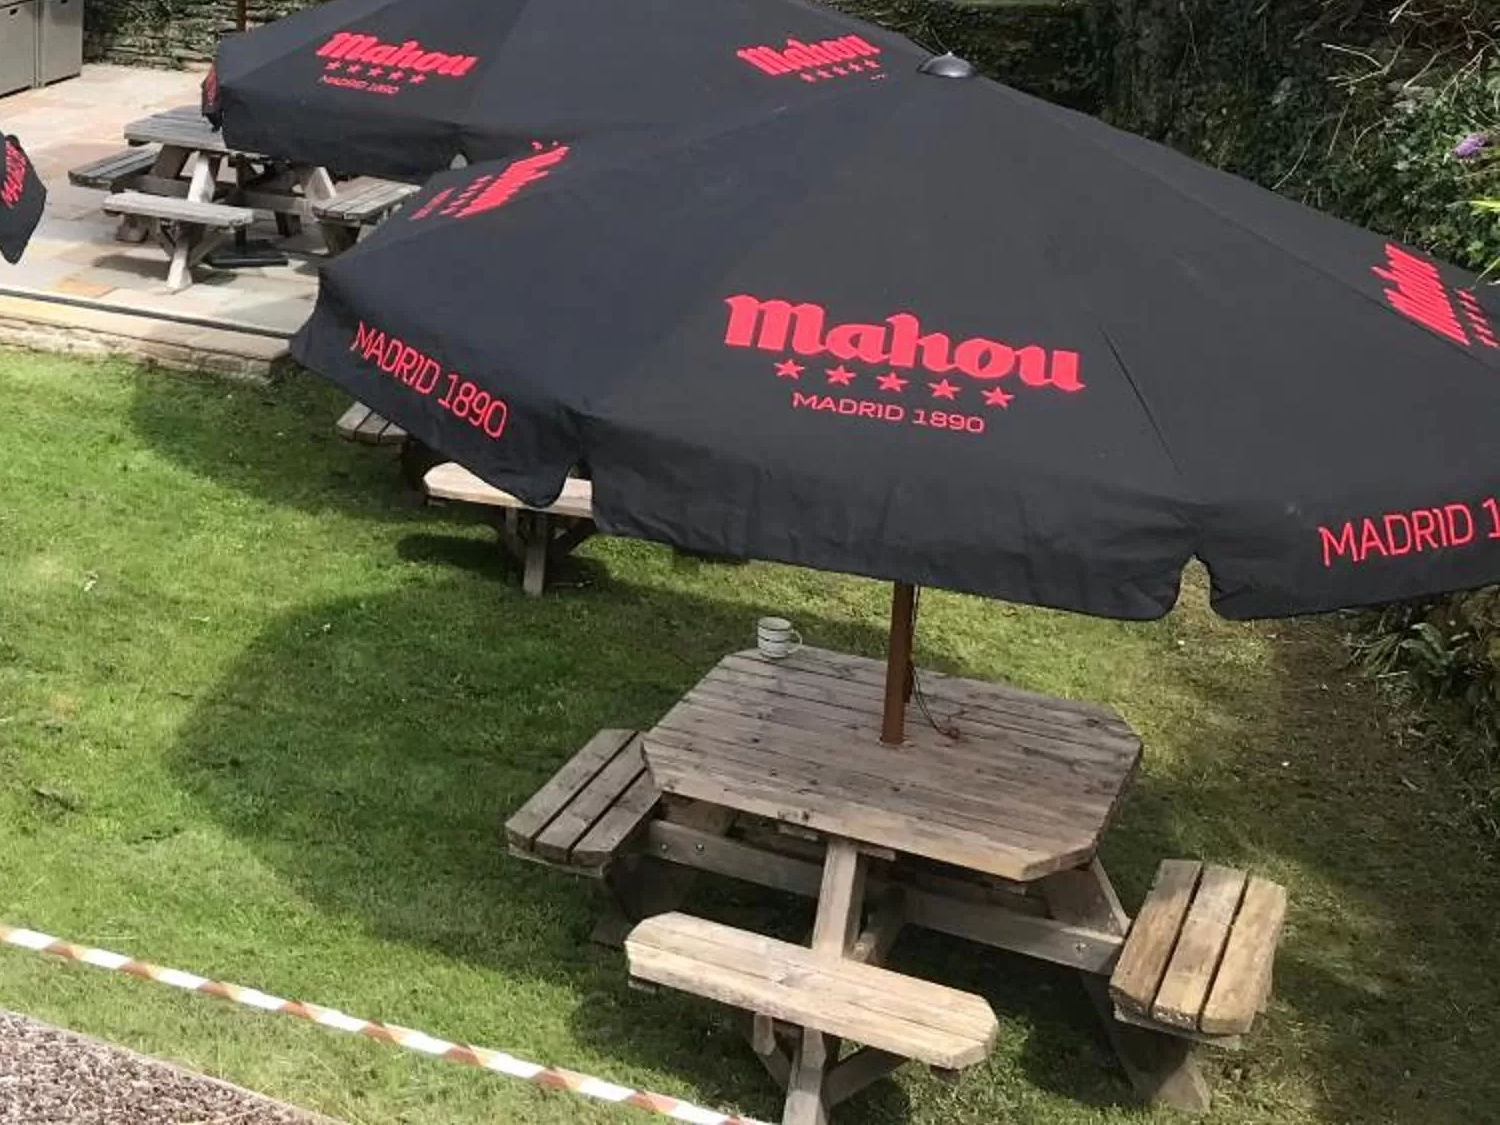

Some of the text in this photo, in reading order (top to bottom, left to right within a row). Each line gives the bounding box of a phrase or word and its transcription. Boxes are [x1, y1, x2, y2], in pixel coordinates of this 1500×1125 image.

[315, 32, 479, 77] Mahou
[736, 34, 881, 76] Mahou
[723, 294, 1085, 392] Mahou
[350, 320, 507, 438] MADRID 1890
[792, 392, 985, 433] MADRID 1890
[1318, 503, 1474, 567] MADRID
